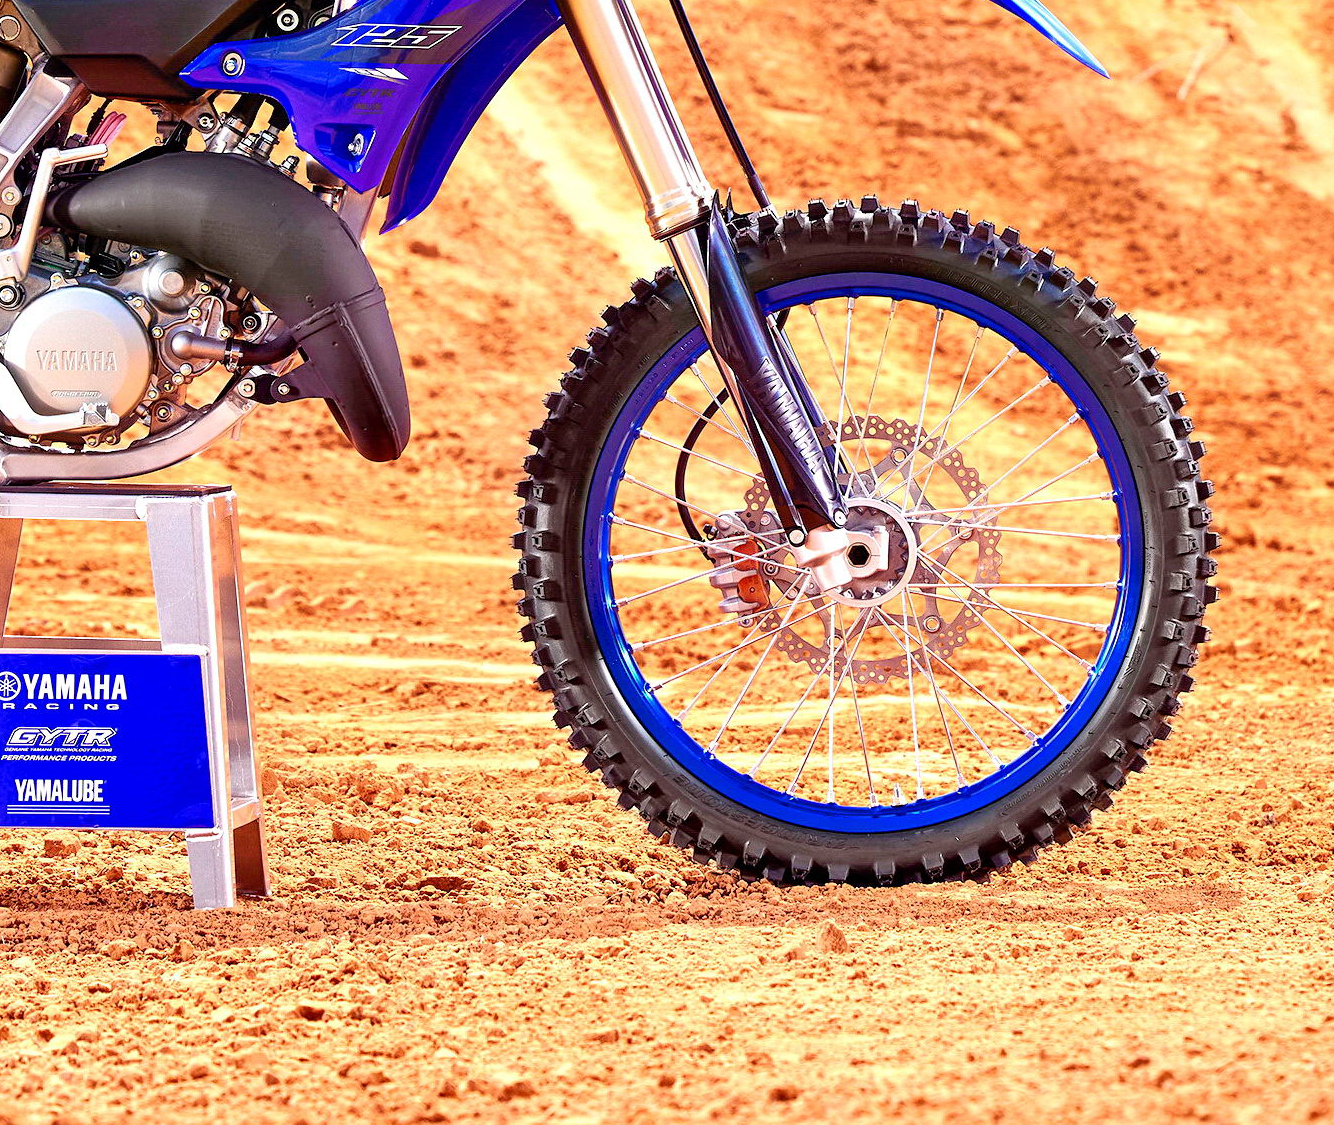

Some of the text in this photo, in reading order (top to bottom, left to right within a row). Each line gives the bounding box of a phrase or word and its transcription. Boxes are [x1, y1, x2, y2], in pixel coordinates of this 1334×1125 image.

[331, 23, 463, 49] 125
[36, 350, 118, 371] YAMAHA
[747, 356, 825, 475] YAMAHA
[22, 673, 128, 700] YAMAHA
[2, 702, 120, 710] RACING
[6, 727, 117, 746] GYTR
[14, 779, 104, 803] YAMALUBE
